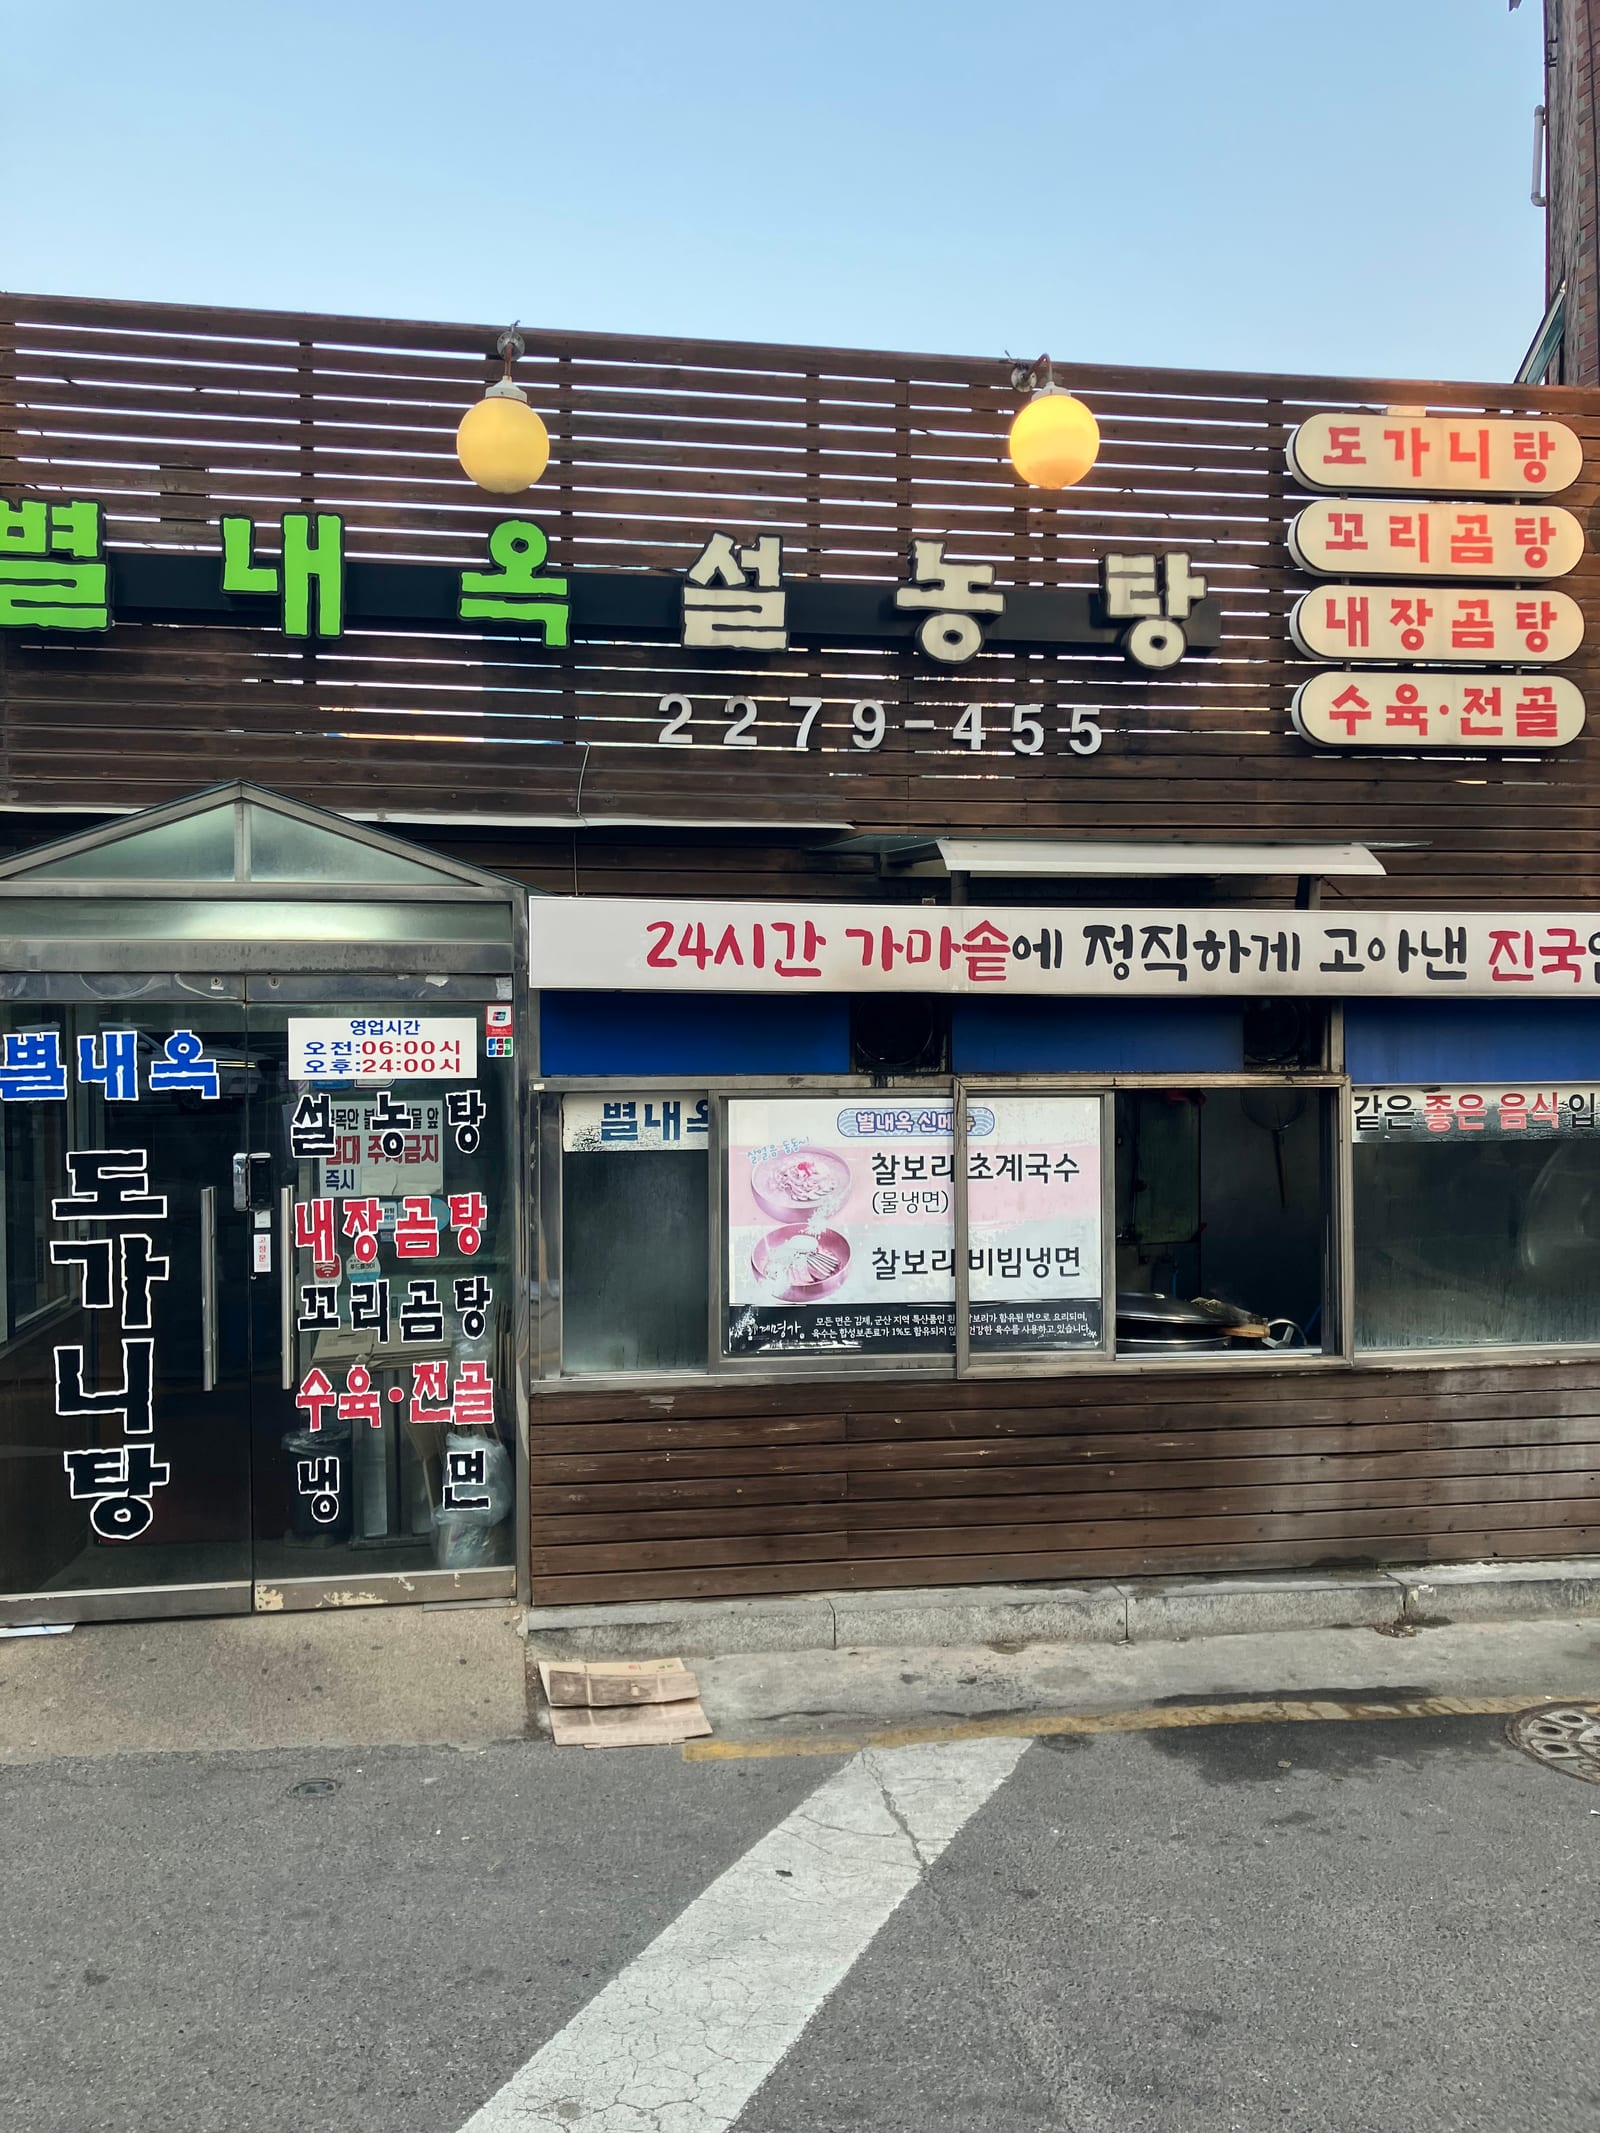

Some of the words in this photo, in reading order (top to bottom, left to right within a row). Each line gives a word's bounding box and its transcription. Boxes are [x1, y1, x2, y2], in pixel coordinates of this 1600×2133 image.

[1323, 427, 1556, 483] 도가니탕
[1325, 513, 1557, 569] 꼬리곰탕
[683, 531, 1207, 668] 설농탕
[1326, 596, 1558, 653] 내장곰탕
[658, 693, 1102, 756] 2279-455
[1329, 683, 1558, 737] 수육·전골
[646, 920, 827, 978] 24시간
[845, 920, 1062, 982] 가마솥에
[1083, 924, 1300, 982] 정직하게
[1320, 926, 1467, 981] 고아낸
[350, 1020, 421, 1036] 영업시간
[0, 1029, 221, 1101] 별내옥
[290, 1090, 487, 1158] 설농탕
[427, 1107, 439, 1129] 앞
[856, 1110, 915, 1133] 별내옥
[1423, 1093, 1487, 1133] 좋은
[367, 1134, 439, 1165] 주금지
[872, 1152, 955, 1186] 찰보리
[967, 1152, 1080, 1184] 초계국수
[325, 1168, 355, 1191] 즉시
[872, 1190, 950, 1215] (물냉면)
[294, 1192, 488, 1264] 내장곰탕
[872, 1247, 956, 1281] 찰보리
[968, 1246, 1081, 1279] 비빔냉면
[298, 1276, 493, 1344] 꼬리곰탕
[815, 1315, 834, 1327] 모든
[893, 1314, 910, 1325] 지역
[50, 1148, 171, 1540] 도가니탕
[296, 1360, 495, 1433] 수육·전골
[297, 1448, 491, 1524] 냉면
